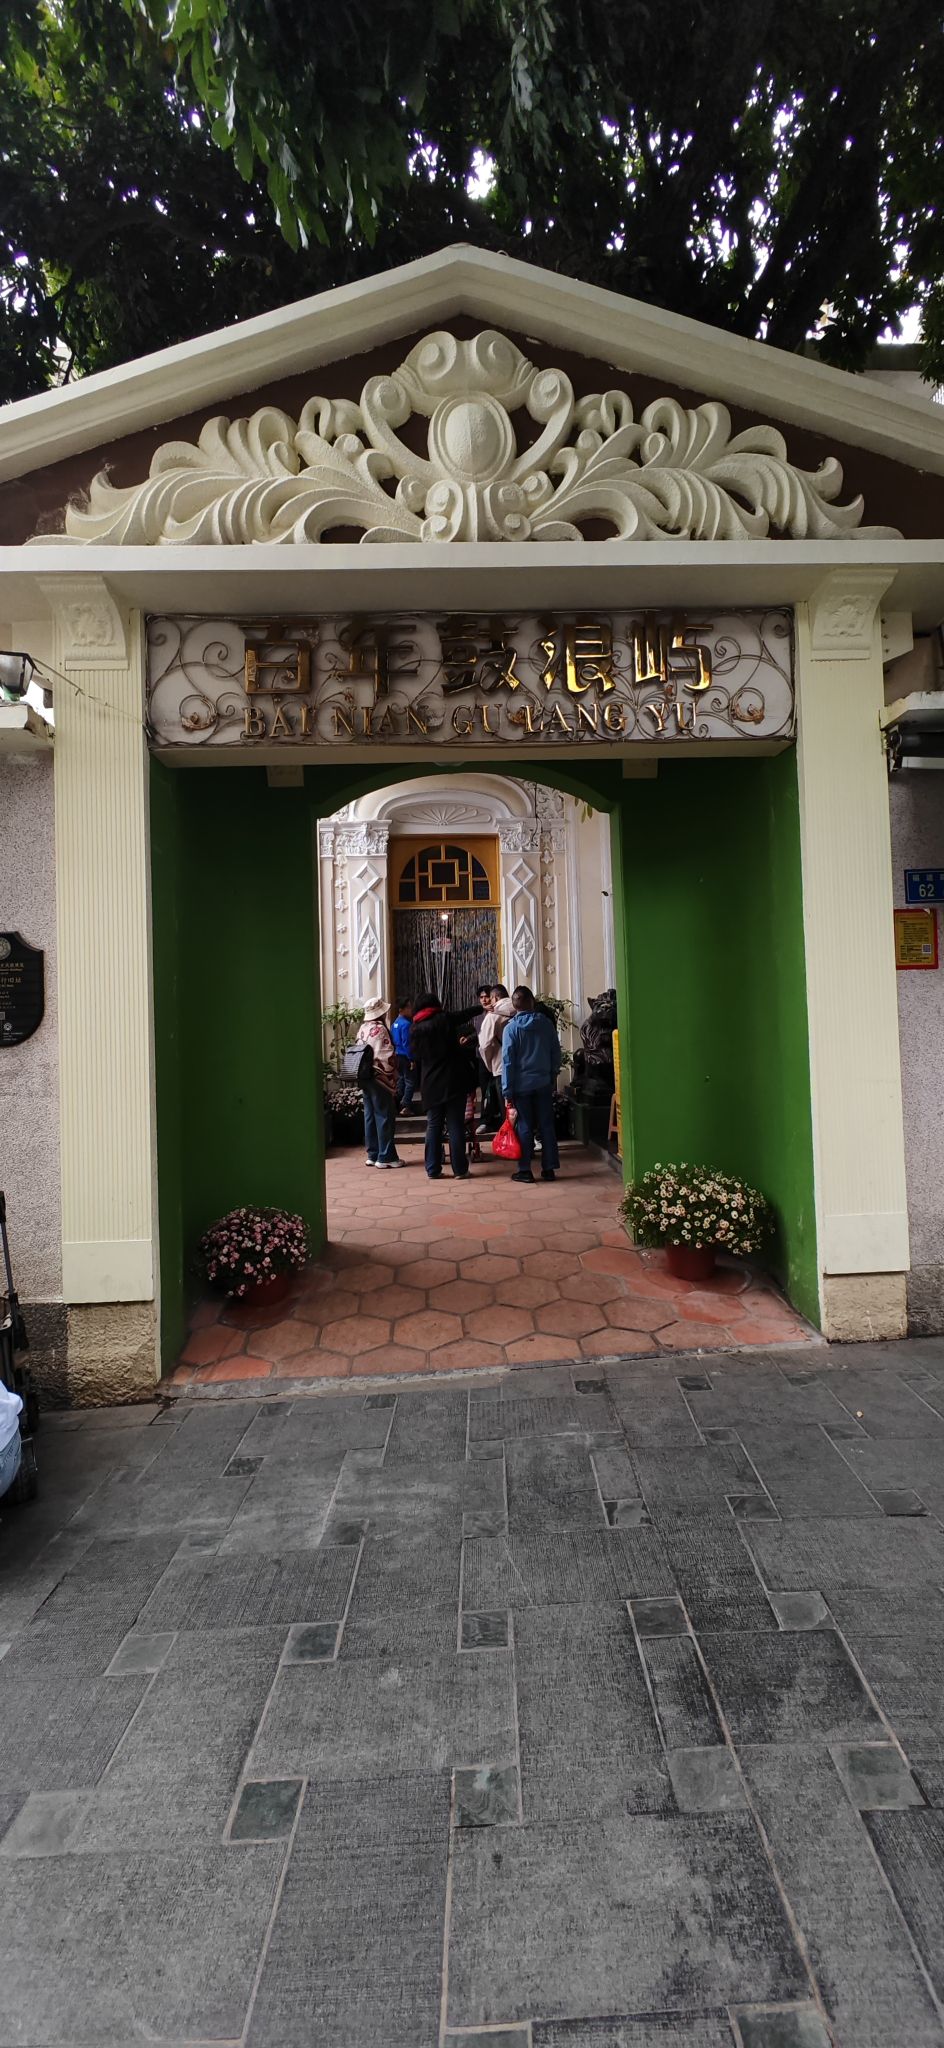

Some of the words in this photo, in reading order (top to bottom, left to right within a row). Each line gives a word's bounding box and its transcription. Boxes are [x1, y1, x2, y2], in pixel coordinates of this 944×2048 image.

[239, 613, 714, 697] 百年鼓浪屿
[242, 704, 313, 738] BAI
[333, 703, 429, 737] NIAN
[451, 703, 501, 736] GU
[522, 702, 628, 735] LANG
[645, 701, 698, 734] YU
[919, 883, 935, 897] 62
